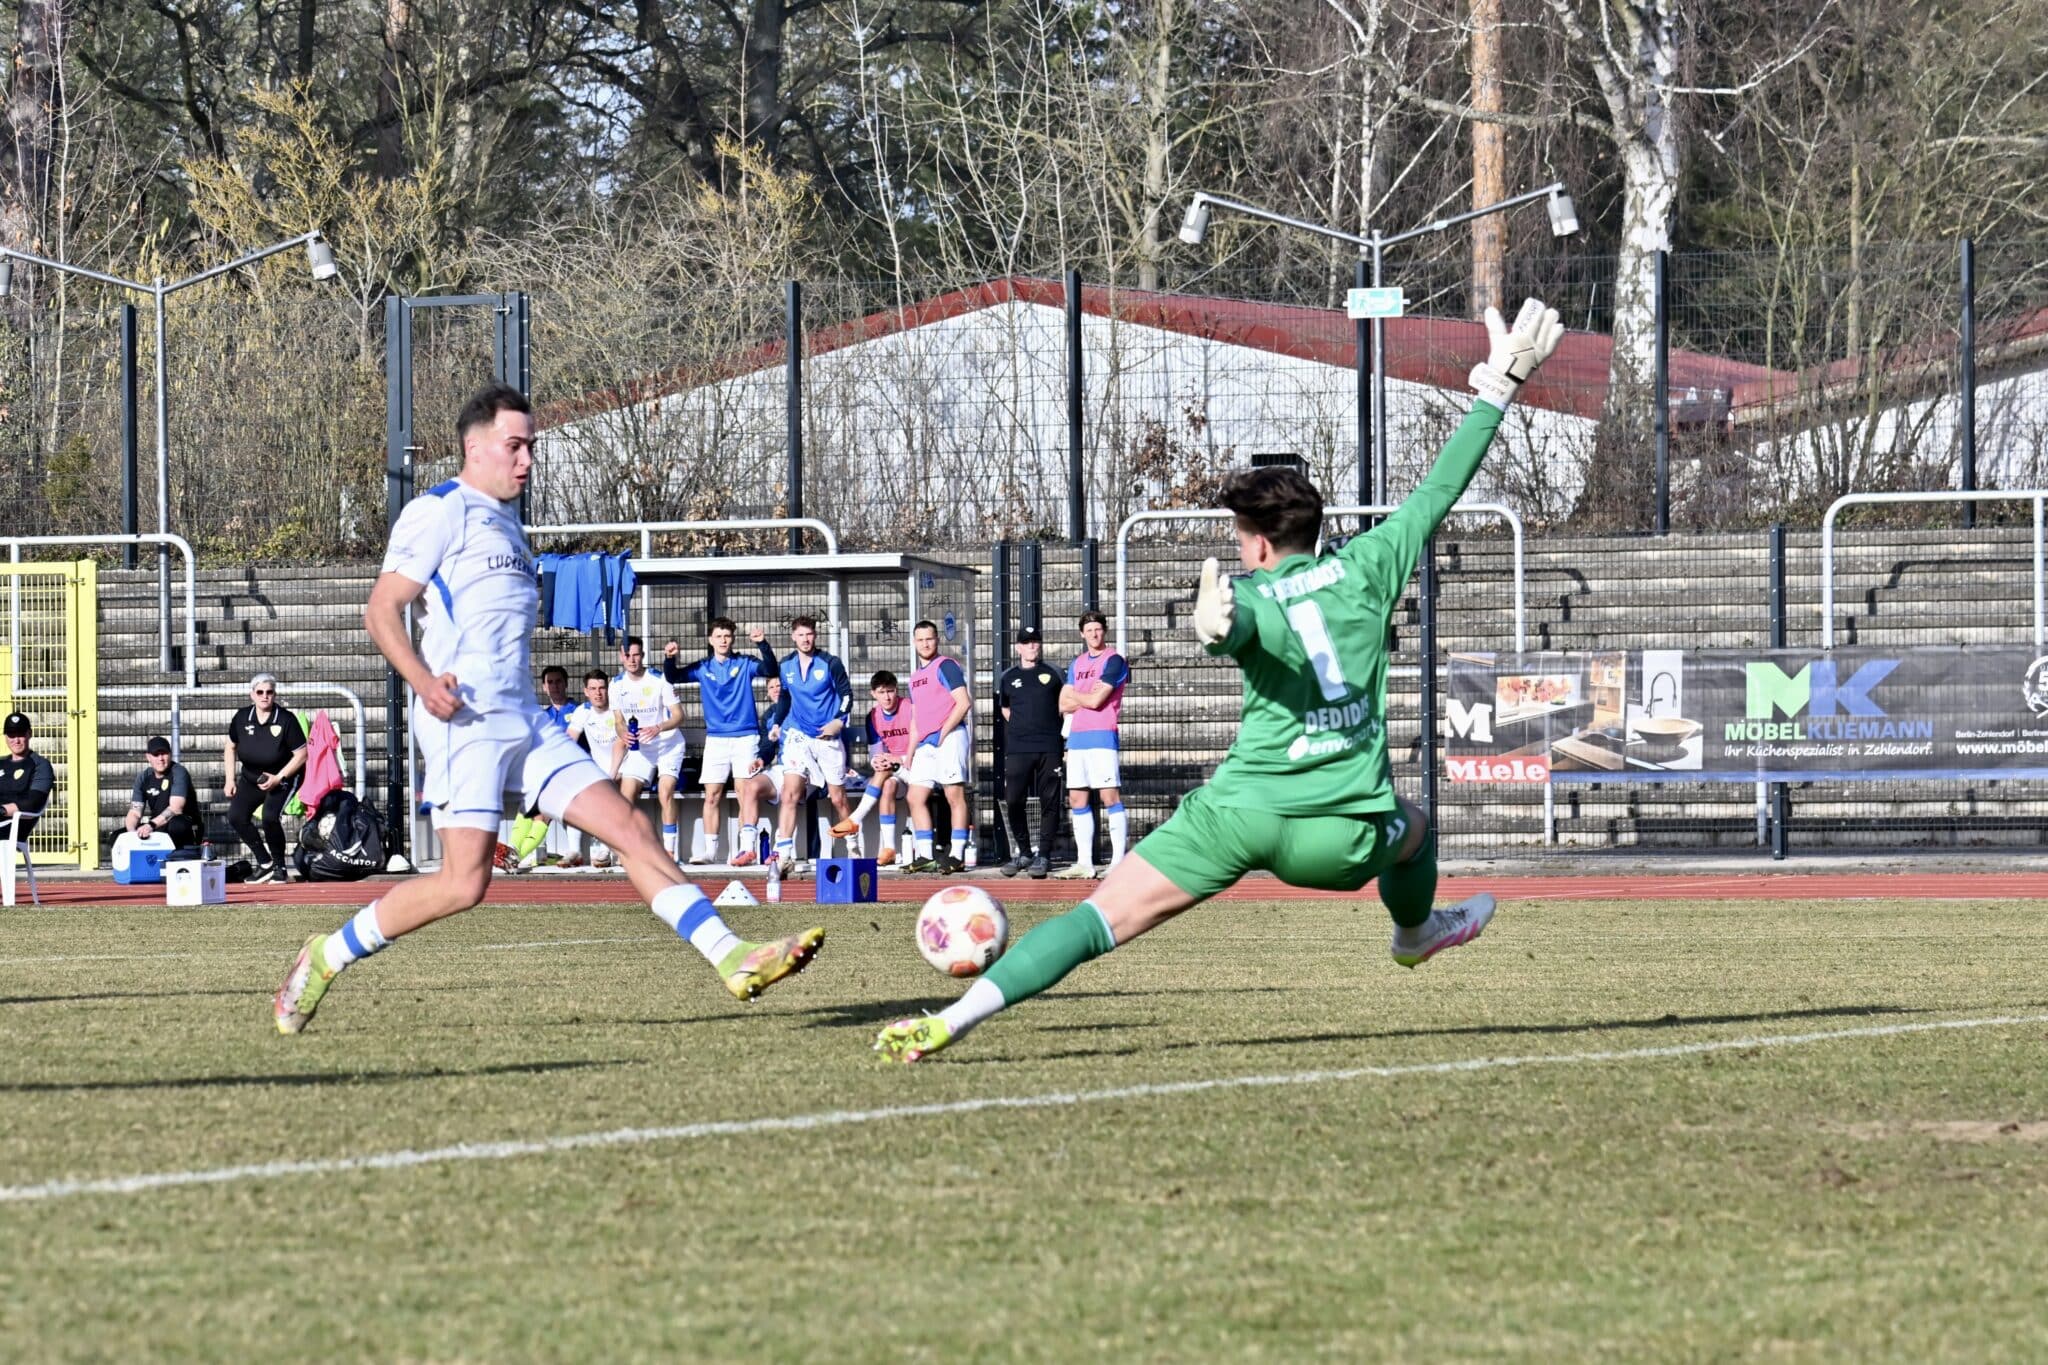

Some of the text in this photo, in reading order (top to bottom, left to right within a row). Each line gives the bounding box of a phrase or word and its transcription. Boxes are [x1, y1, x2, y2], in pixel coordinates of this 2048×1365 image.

[1287, 599, 1350, 702] 1
[1746, 658, 1902, 719] MK
[1807, 720, 1934, 740] KLIEMANN
[1724, 741, 1933, 760] Ihr Küchenspezialist in Zehlendorf.
[1446, 759, 1547, 781] Miele
